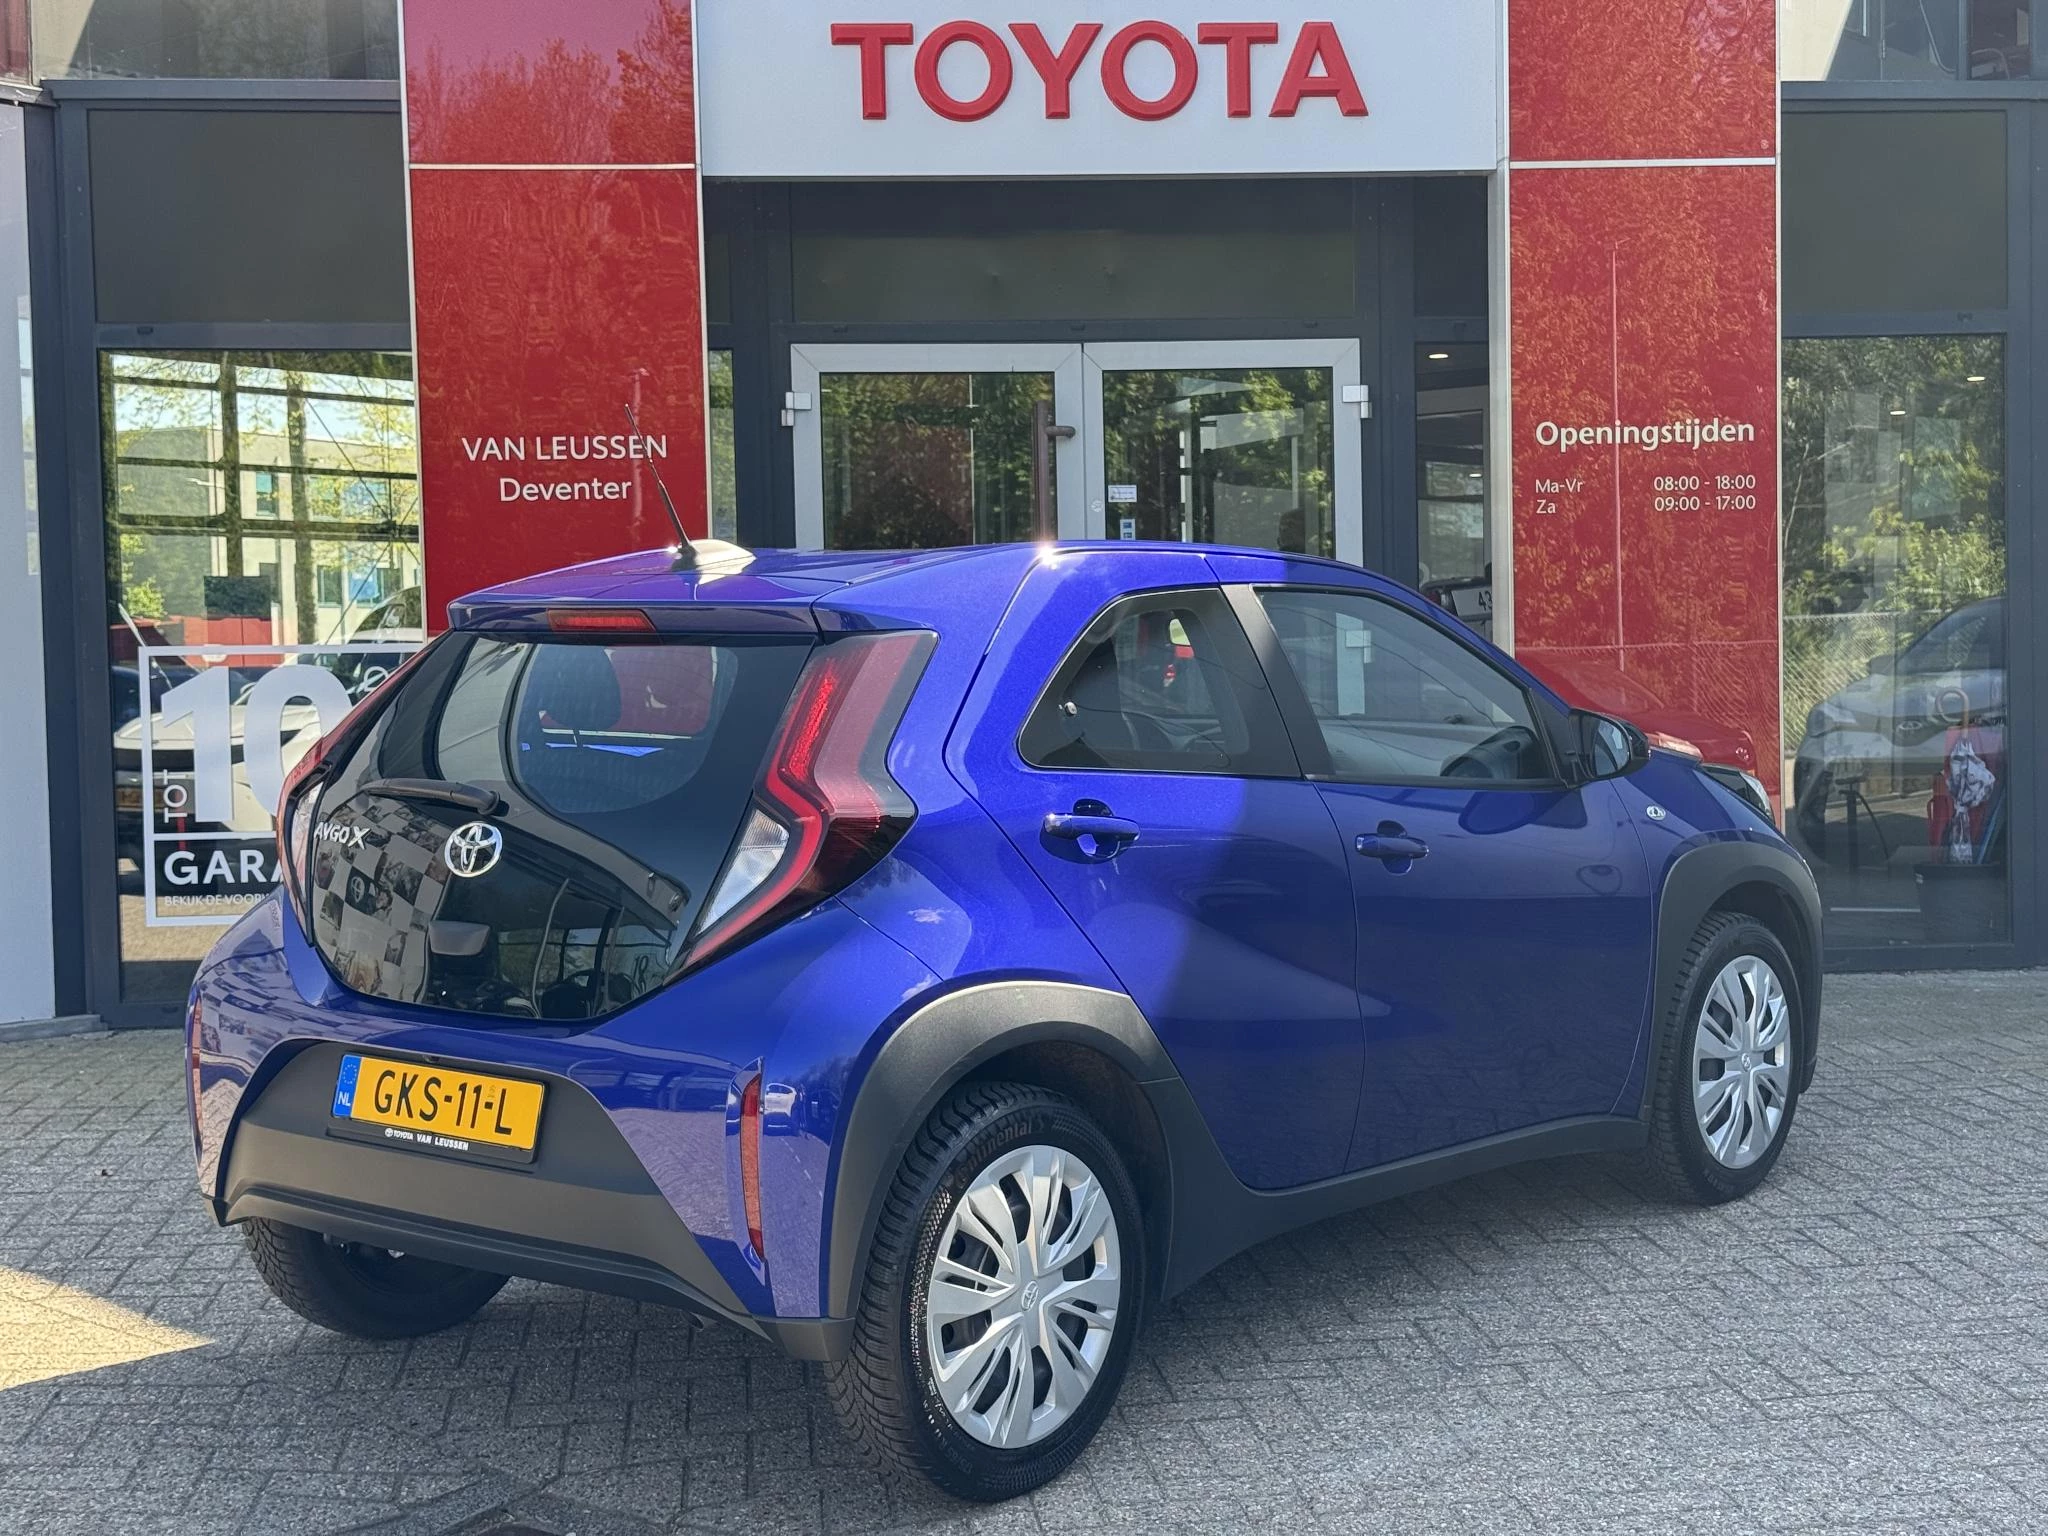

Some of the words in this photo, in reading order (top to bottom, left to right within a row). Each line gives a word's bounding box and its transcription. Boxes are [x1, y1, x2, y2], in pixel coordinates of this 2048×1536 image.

[830, 19, 1369, 122] TOYOTA
[461, 437, 525, 461] VAN
[536, 434, 667, 460] LEUSSEN
[1535, 417, 1755, 453] Openingstijden
[499, 477, 632, 502] Deventer
[1535, 478, 1584, 493] Ma-Vr
[1653, 475, 1700, 492] 08:00
[1715, 474, 1756, 490] 18:00
[1536, 499, 1556, 514] Za
[1654, 495, 1700, 512] 09:00
[1715, 494, 1756, 511] 17:00
[163, 769, 188, 824] TOT
[206, 895, 223, 905] DE
[337, 1091, 351, 1107] NL
[374, 1069, 513, 1136] GKS-11-L
[393, 1129, 414, 1141] TOYOTA
[416, 1133, 432, 1144] VAN
[434, 1136, 469, 1151] LEUSSEN
